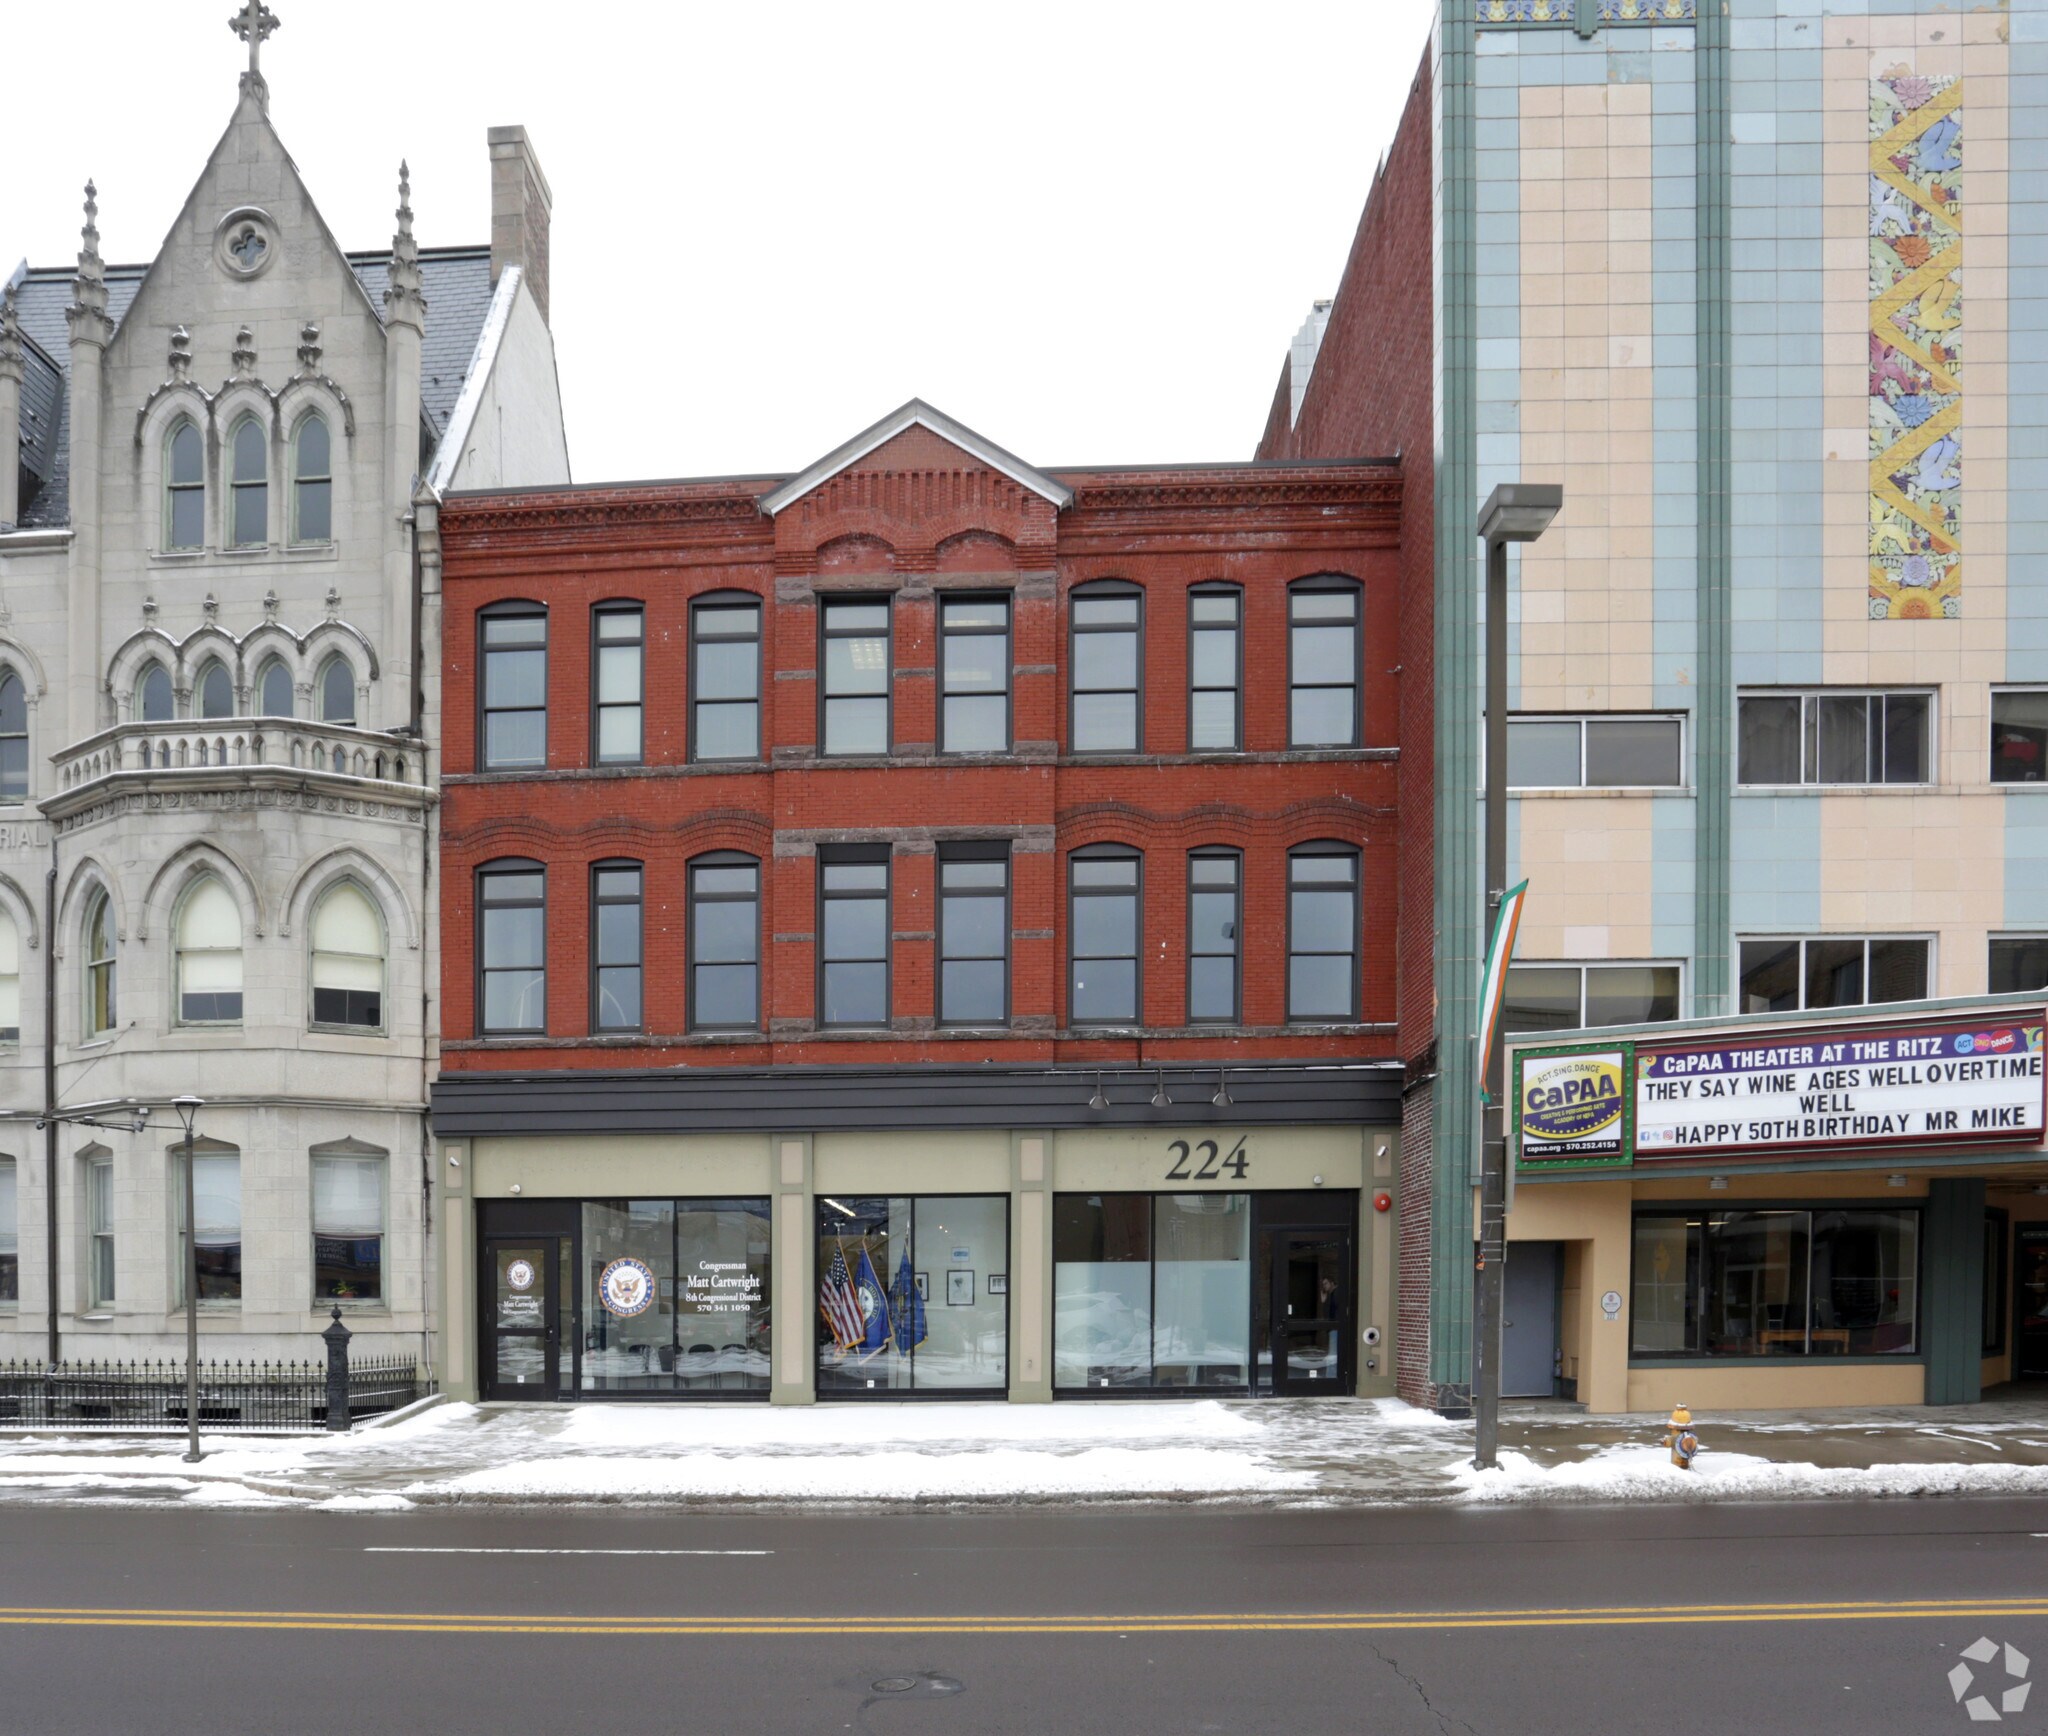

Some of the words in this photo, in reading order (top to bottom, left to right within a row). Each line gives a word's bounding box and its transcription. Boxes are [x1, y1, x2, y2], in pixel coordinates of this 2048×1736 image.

[1957, 1039, 1972, 1049] ACT
[1991, 1034, 2014, 1048] DANCE
[1663, 1053, 1723, 1074] CaPAA
[1729, 1047, 1813, 1069] THEATER
[1820, 1044, 1845, 1063] AT
[1852, 1041, 1889, 1060] THE
[1897, 1037, 1942, 1057] RITZ
[1646, 1080, 1692, 1101] THEY
[1700, 1078, 1739, 1098] SAY
[1748, 1073, 1796, 1094] WINE
[1808, 1069, 1860, 1091] AGES
[1869, 1065, 1922, 1087] WELL
[1527, 1074, 1617, 1112] CaPAA
[1800, 1093, 1855, 1114] WELL
[1675, 1123, 1743, 1144] HAPPY
[1749, 1120, 1798, 1140] 50TH
[1804, 1113, 1910, 1137] BIRTHDAY
[1926, 1110, 1958, 1130] MR
[1971, 1106, 2025, 1128] MIKE
[1526, 1145, 1561, 1154] capaa.org
[1566, 1141, 1617, 1150] 570.252.4156
[1165, 1134, 1250, 1179] 224
[602, 1261, 625, 1287] UNITED
[631, 1261, 651, 1287] STATES
[699, 1261, 747, 1272] Congressman
[687, 1274, 709, 1288] Matt
[711, 1274, 760, 1291] Cartwright
[685, 1292, 697, 1302] 8th
[698, 1292, 738, 1304] Congressional
[739, 1292, 762, 1301] District
[608, 1300, 646, 1314] CONGRESS
[697, 1304, 712, 1312] 570
[713, 1304, 727, 1312] 341
[731, 1304, 751, 1312] 1050
